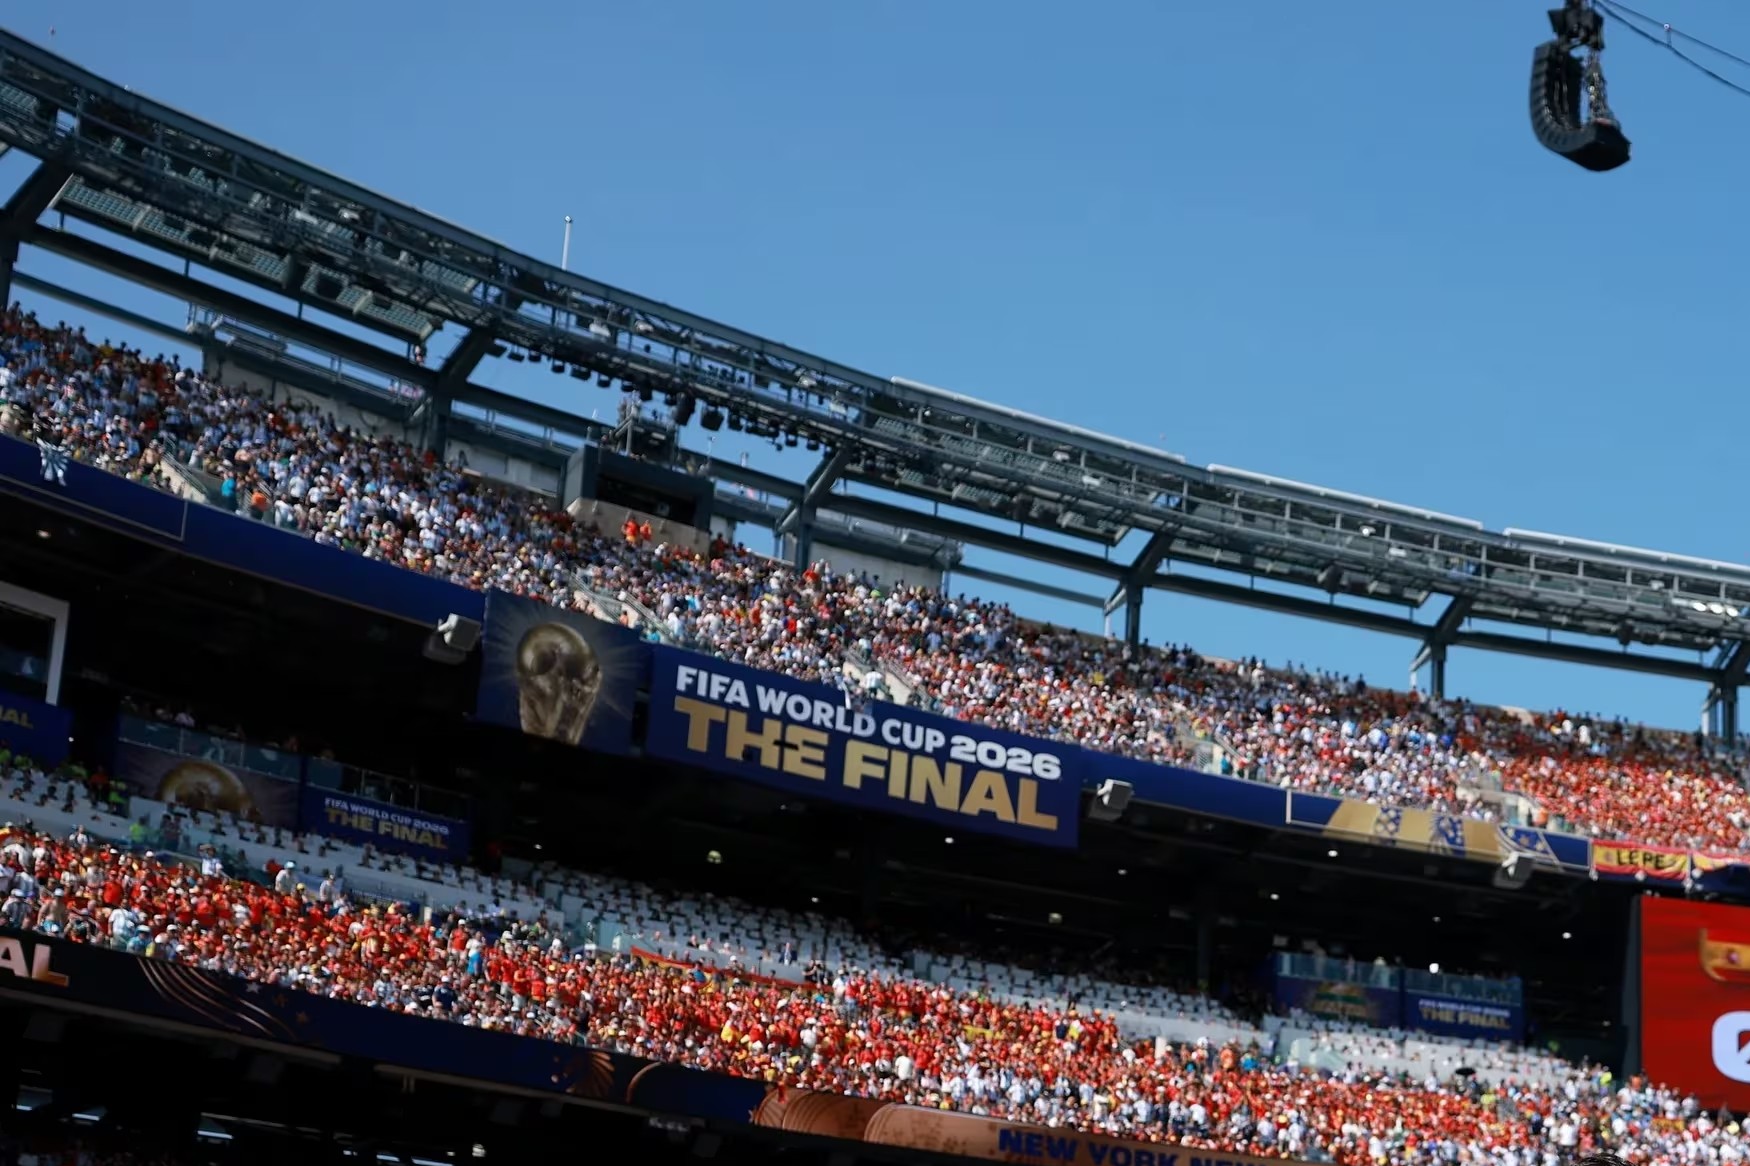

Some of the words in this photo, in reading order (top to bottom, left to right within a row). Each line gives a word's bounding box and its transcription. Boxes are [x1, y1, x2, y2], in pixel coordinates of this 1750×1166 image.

[675, 665, 749, 709] FIFA
[756, 685, 876, 740] WORLD
[881, 718, 944, 756] CUP
[950, 735, 1062, 781] 2026
[674, 697, 826, 781] THE
[842, 742, 1058, 831] FINAL
[324, 797, 349, 812] FIFA
[350, 803, 389, 821] WORLD
[325, 808, 374, 833] THE
[378, 822, 448, 850] FINAL
[999, 1128, 1080, 1162] NEW
